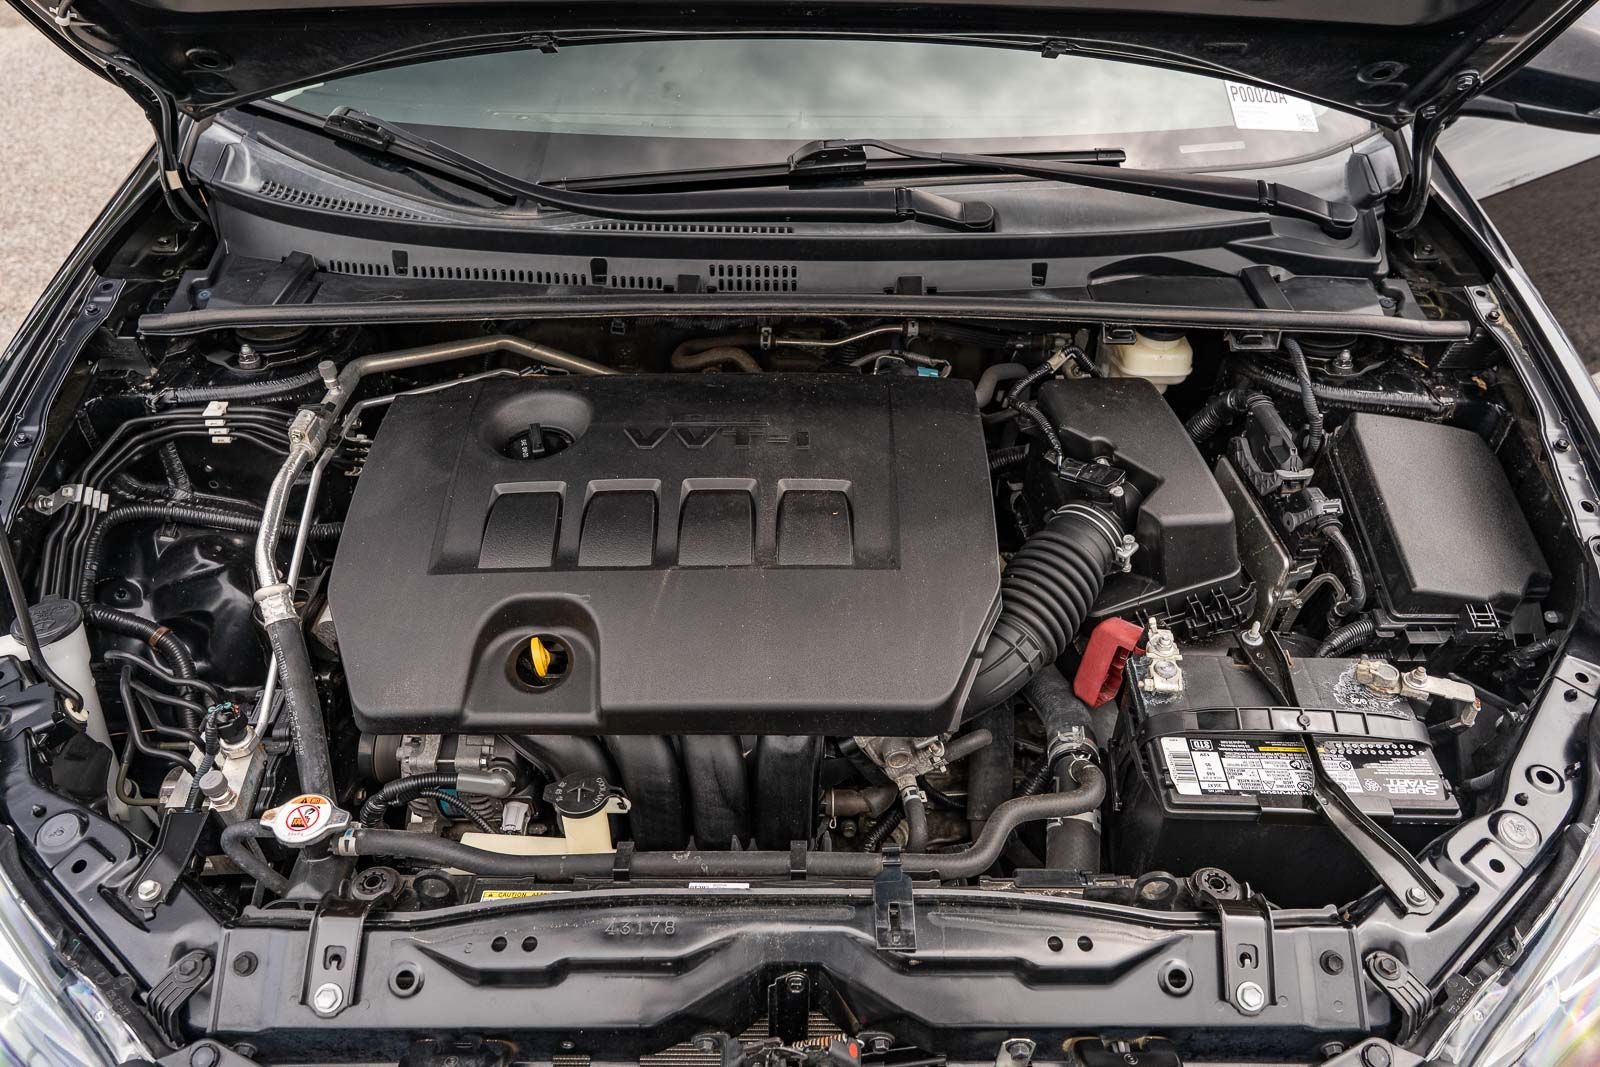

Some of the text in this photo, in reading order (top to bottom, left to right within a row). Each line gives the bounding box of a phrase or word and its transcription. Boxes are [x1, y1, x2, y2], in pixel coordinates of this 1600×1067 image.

[1389, 778, 1440, 789] START
[1389, 787, 1437, 796] SUPER
[604, 919, 677, 935] 43178
